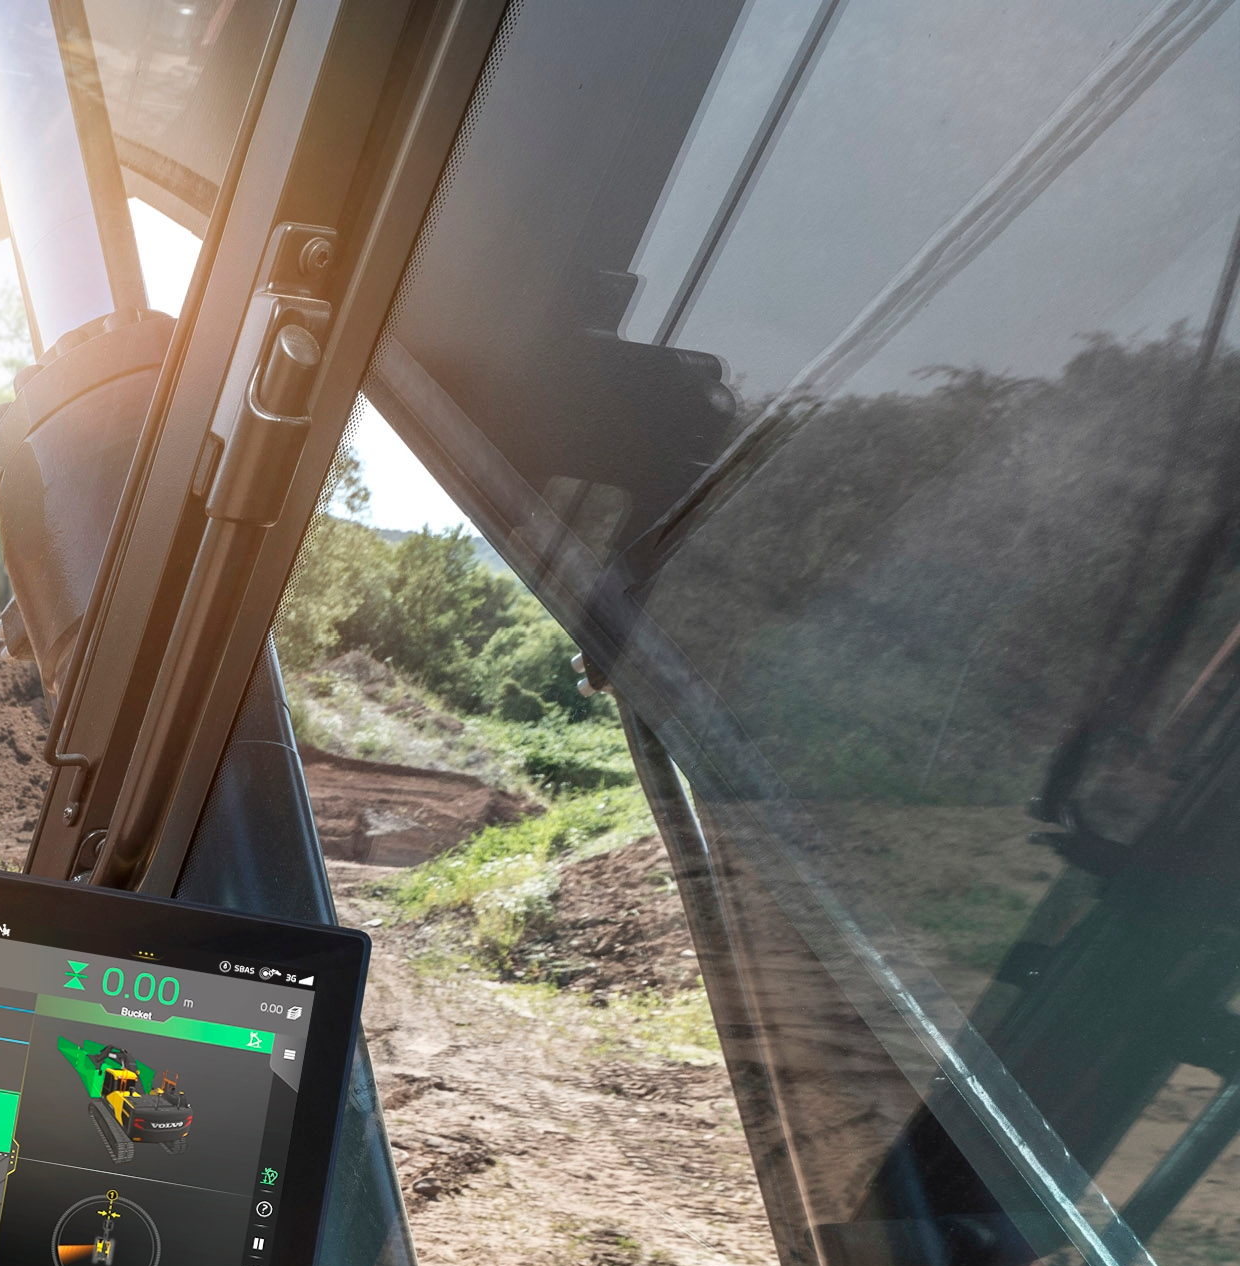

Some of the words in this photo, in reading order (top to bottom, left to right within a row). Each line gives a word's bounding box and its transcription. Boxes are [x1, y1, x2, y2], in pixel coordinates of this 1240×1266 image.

[234, 964, 255, 975] SBAS
[286, 973, 297, 983] 3G
[102, 967, 180, 1006] 0.00
[183, 999, 194, 1008] m
[121, 1007, 153, 1021] Bucket
[260, 1002, 283, 1014] 0.00
